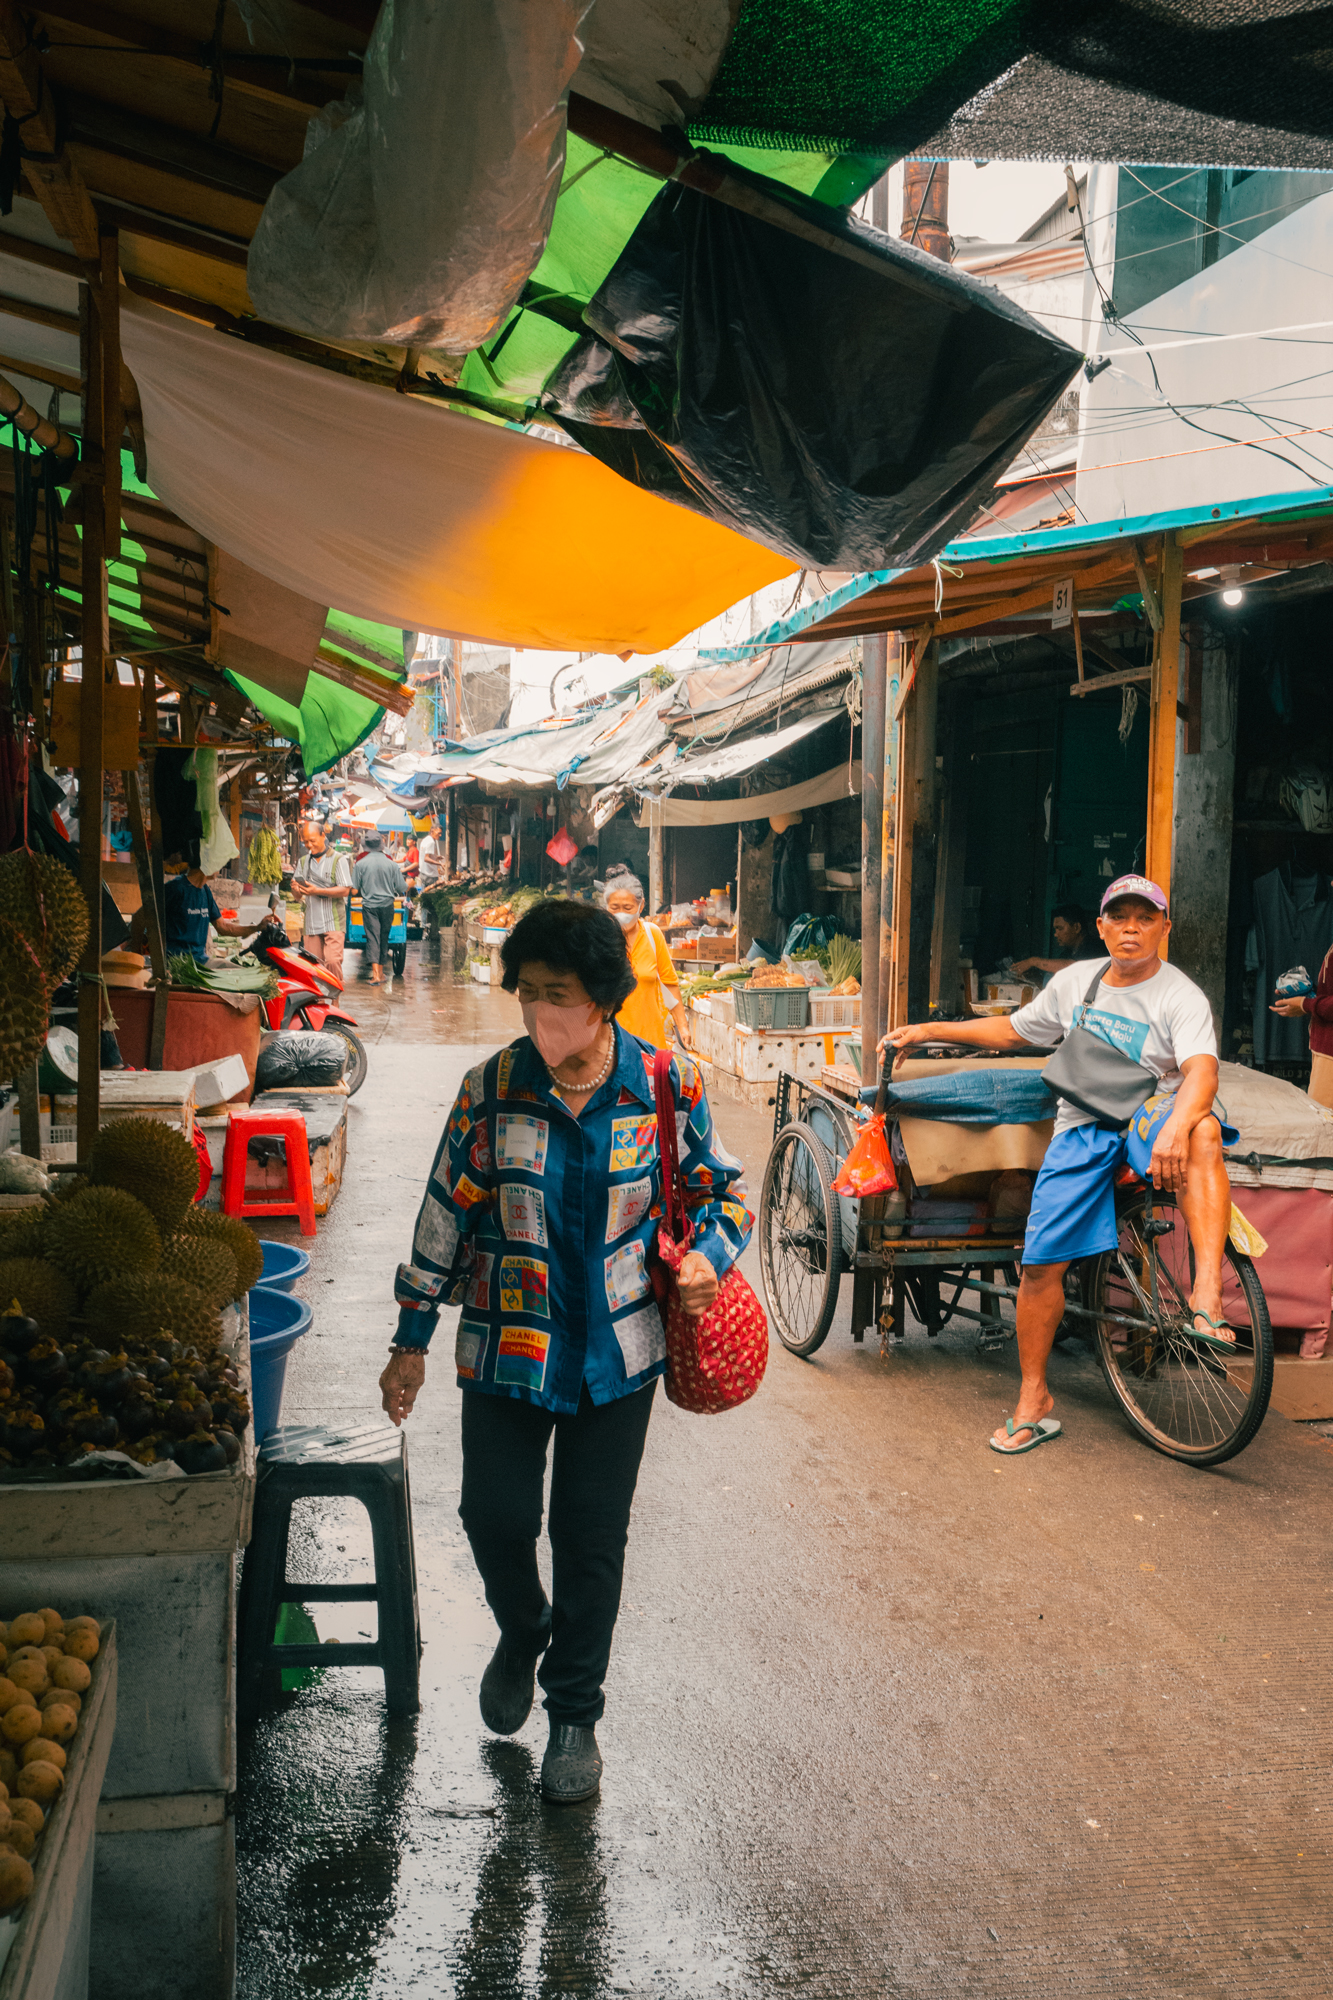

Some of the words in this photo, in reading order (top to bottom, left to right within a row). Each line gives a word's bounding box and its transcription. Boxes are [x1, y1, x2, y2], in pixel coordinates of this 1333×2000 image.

[1056, 588, 1068, 610] 51
[1085, 1013, 1113, 1027] karta
[1114, 1020, 1136, 1034] Baru
[1110, 1029, 1132, 1044] Maju
[504, 1186, 542, 1201] CHANEL
[619, 1181, 651, 1196] CHANEL
[609, 1189, 620, 1232] CHANEL
[535, 1203, 545, 1245] CHANEL
[505, 1258, 542, 1271] CHANEL
[505, 1330, 543, 1345] CHANEL
[505, 1344, 538, 1358] CHANEL
